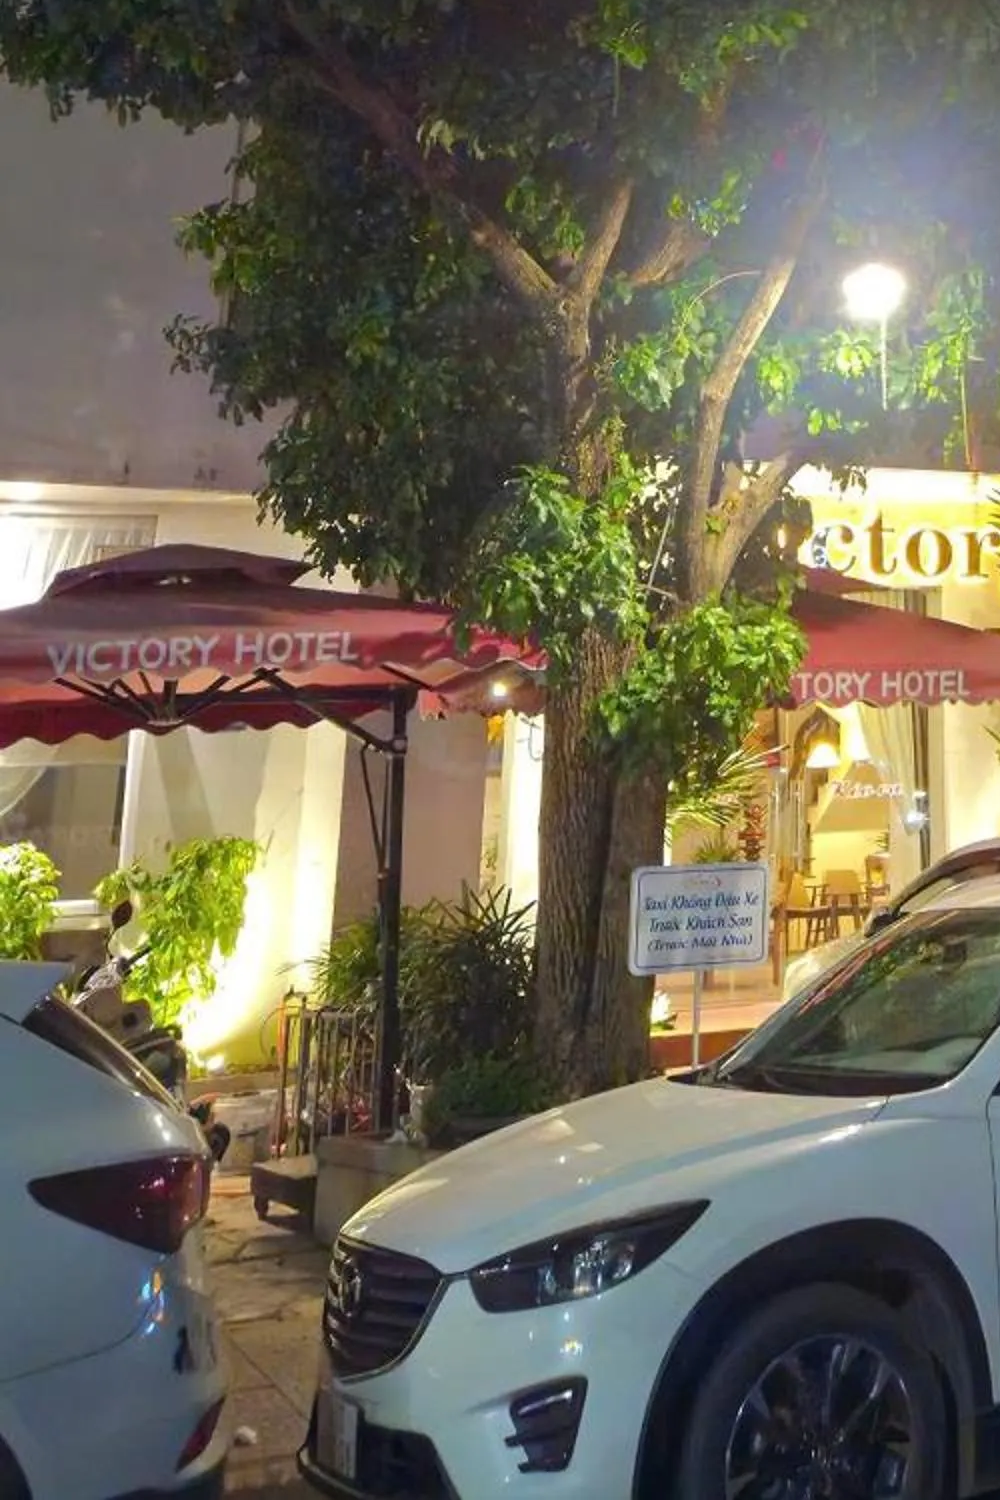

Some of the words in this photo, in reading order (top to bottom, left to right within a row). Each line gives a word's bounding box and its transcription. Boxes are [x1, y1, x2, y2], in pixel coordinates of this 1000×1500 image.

[47, 636, 219, 676] VICTORY
[235, 631, 360, 666] HOTEL
[790, 671, 871, 700] TORY
[881, 669, 970, 697] HOTEL
